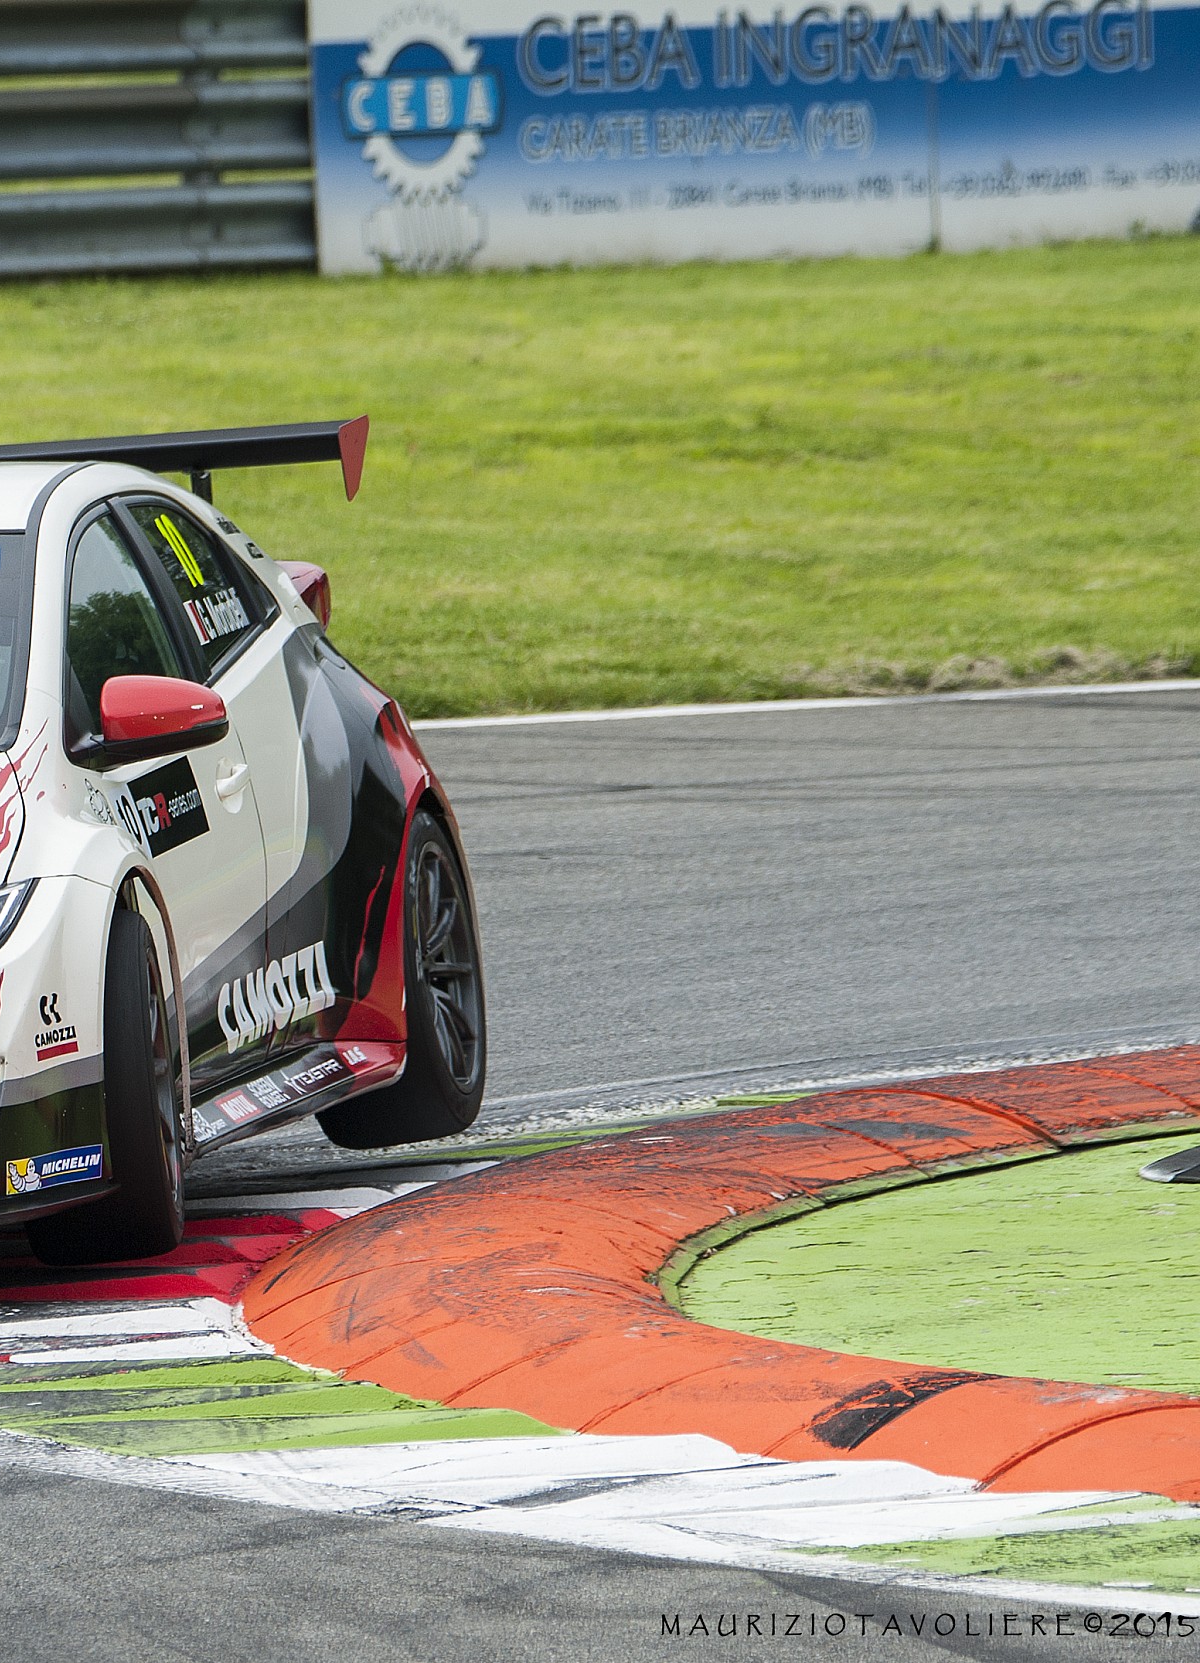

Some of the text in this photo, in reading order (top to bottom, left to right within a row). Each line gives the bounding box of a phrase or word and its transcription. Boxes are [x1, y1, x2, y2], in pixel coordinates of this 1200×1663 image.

[522, 0, 1154, 92] CEBA INGRANAGGI
[346, 76, 496, 133] CEBA
[521, 100, 875, 162] CARATE BRIANZA (MB)
[217, 940, 336, 1055] CAMOZZI
[35, 1025, 77, 1048] CAMOZZI
[220, 1094, 258, 1121] MOTUL
[41, 1152, 100, 1176] MICHELIN
